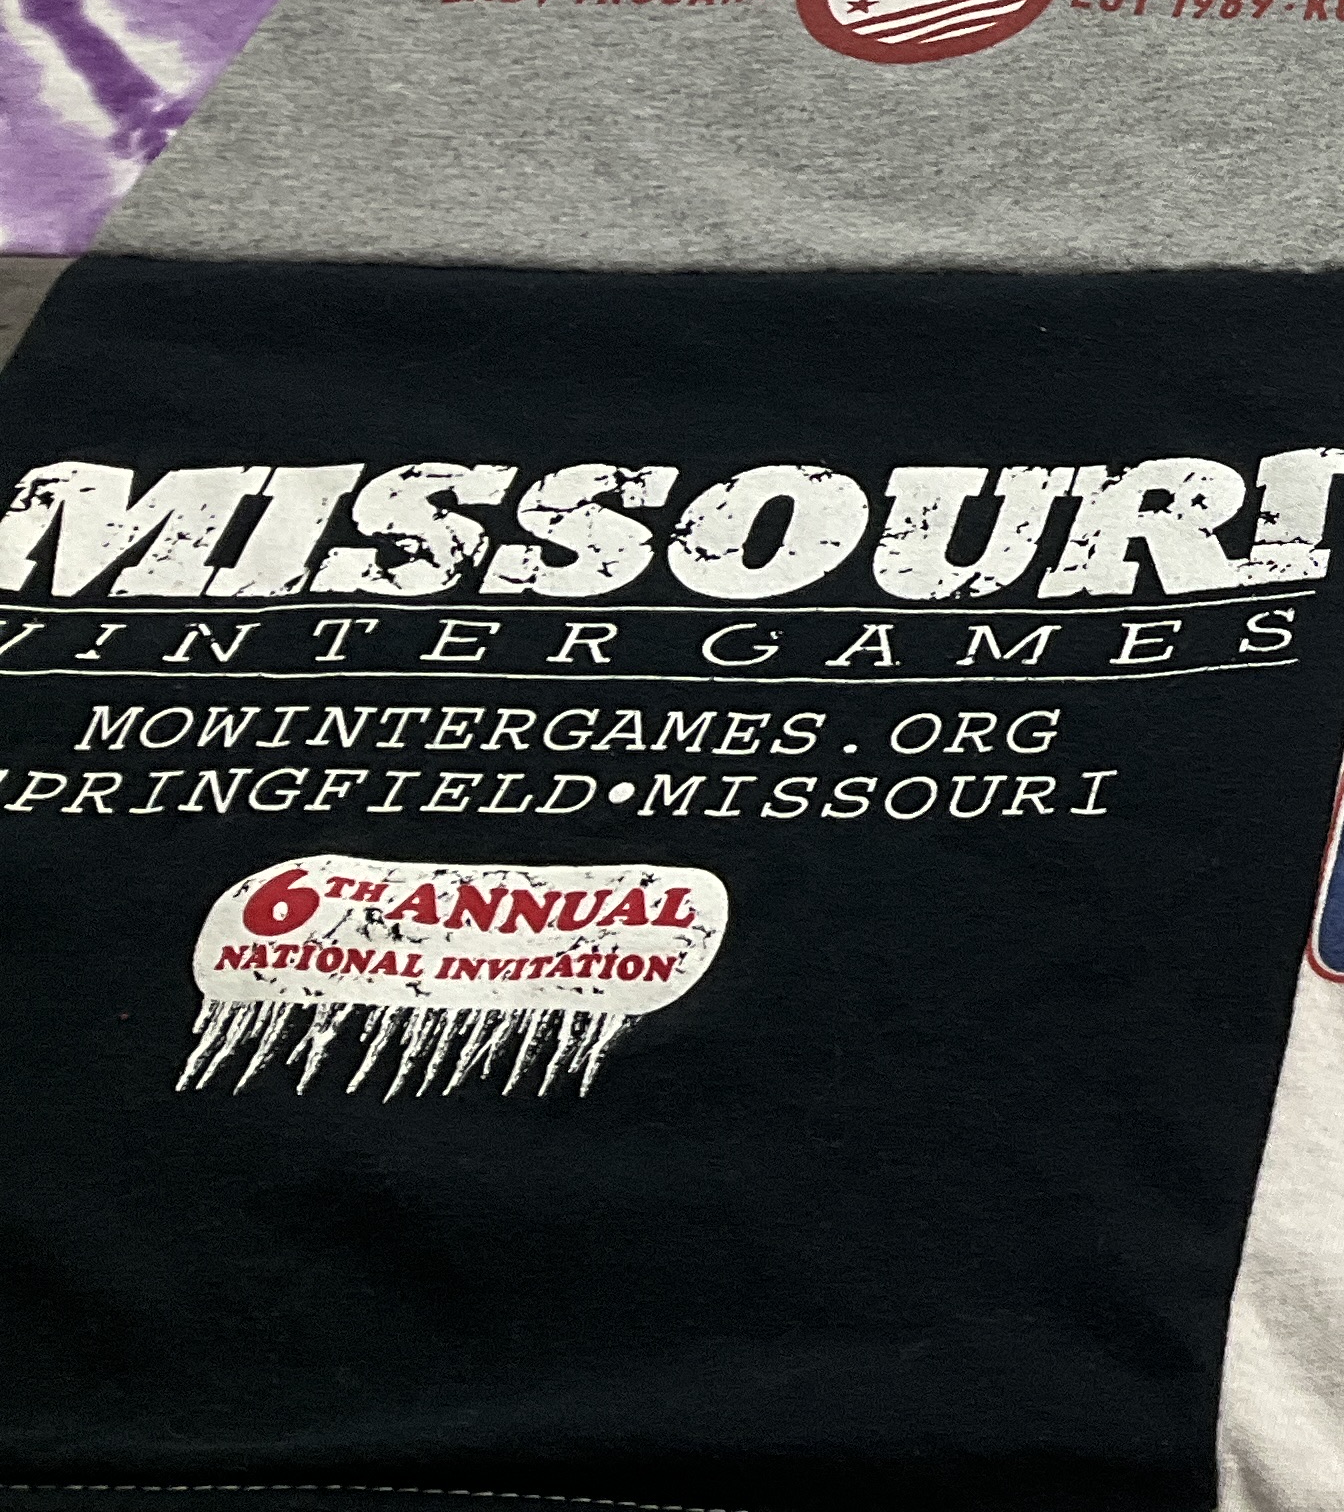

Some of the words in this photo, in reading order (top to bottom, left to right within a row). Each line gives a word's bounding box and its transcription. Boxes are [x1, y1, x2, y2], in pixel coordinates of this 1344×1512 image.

[700, 606, 1300, 670] GAMES
[0, 766, 597, 818] PRINGFIELD
[386, 883, 696, 935] ANNUAL
[214, 944, 425, 978] NATIONAL
[436, 951, 684, 982] INVITATION
